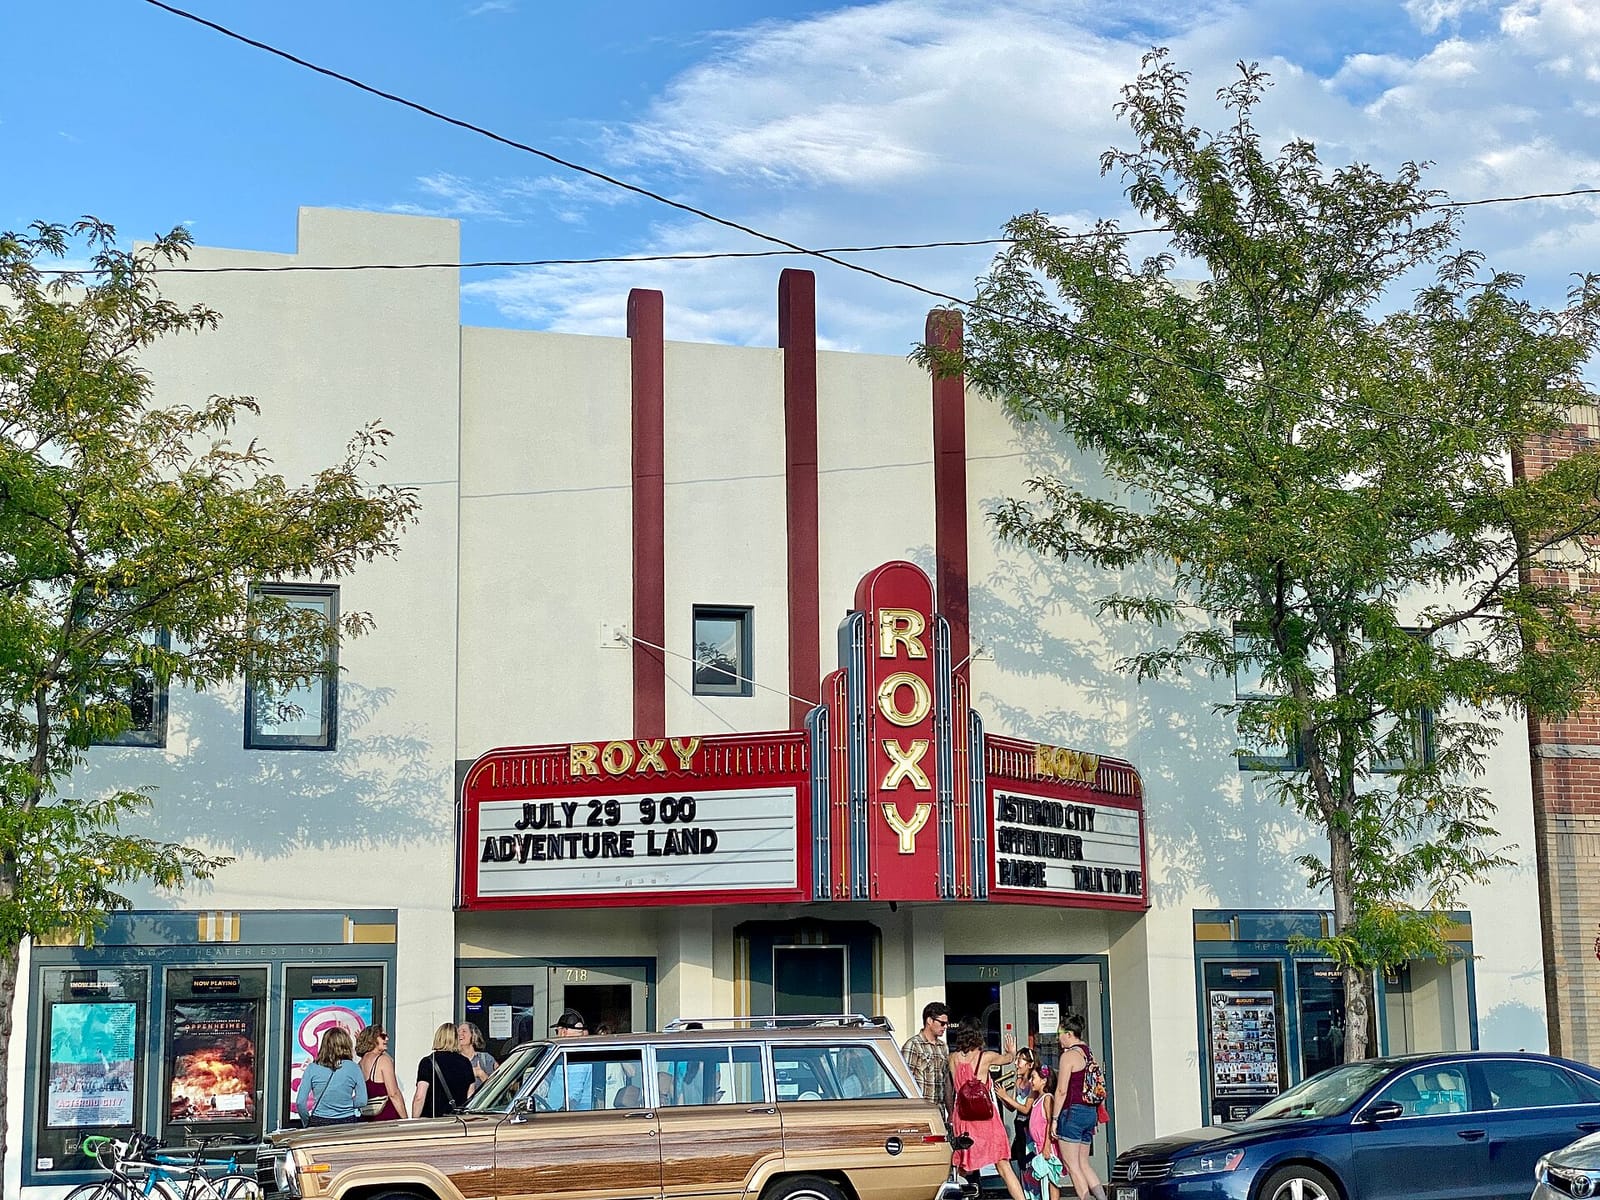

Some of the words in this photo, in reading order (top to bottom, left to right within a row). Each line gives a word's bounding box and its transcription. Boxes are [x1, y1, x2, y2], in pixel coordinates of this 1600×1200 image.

[879, 608, 932, 854] ROXY
[570, 737, 701, 776] ROXY
[1036, 744, 1099, 784] ROXY
[515, 801, 578, 830] JULY
[586, 800, 621, 826] 29
[640, 797, 696, 824] 900
[998, 795, 1064, 829] ASTEROID
[1065, 804, 1096, 832] CITY
[481, 831, 635, 863] ADVENTURE
[648, 828, 718, 856] LAND
[998, 826, 1084, 860] OPPENHEIMER
[1072, 865, 1104, 892] TALK
[1104, 867, 1122, 893] TO
[1125, 870, 1142, 895] ME
[137, 948, 176, 957] ROXY
[186, 948, 252, 957] THEATER
[260, 948, 286, 956] EST
[300, 947, 333, 955] 1937
[566, 969, 588, 981] 718
[979, 966, 1000, 979] 718
[185, 1022, 246, 1031] OPPENHEIMER
[57, 1099, 99, 1108] ASTEROID
[102, 1098, 126, 1108] CITY
